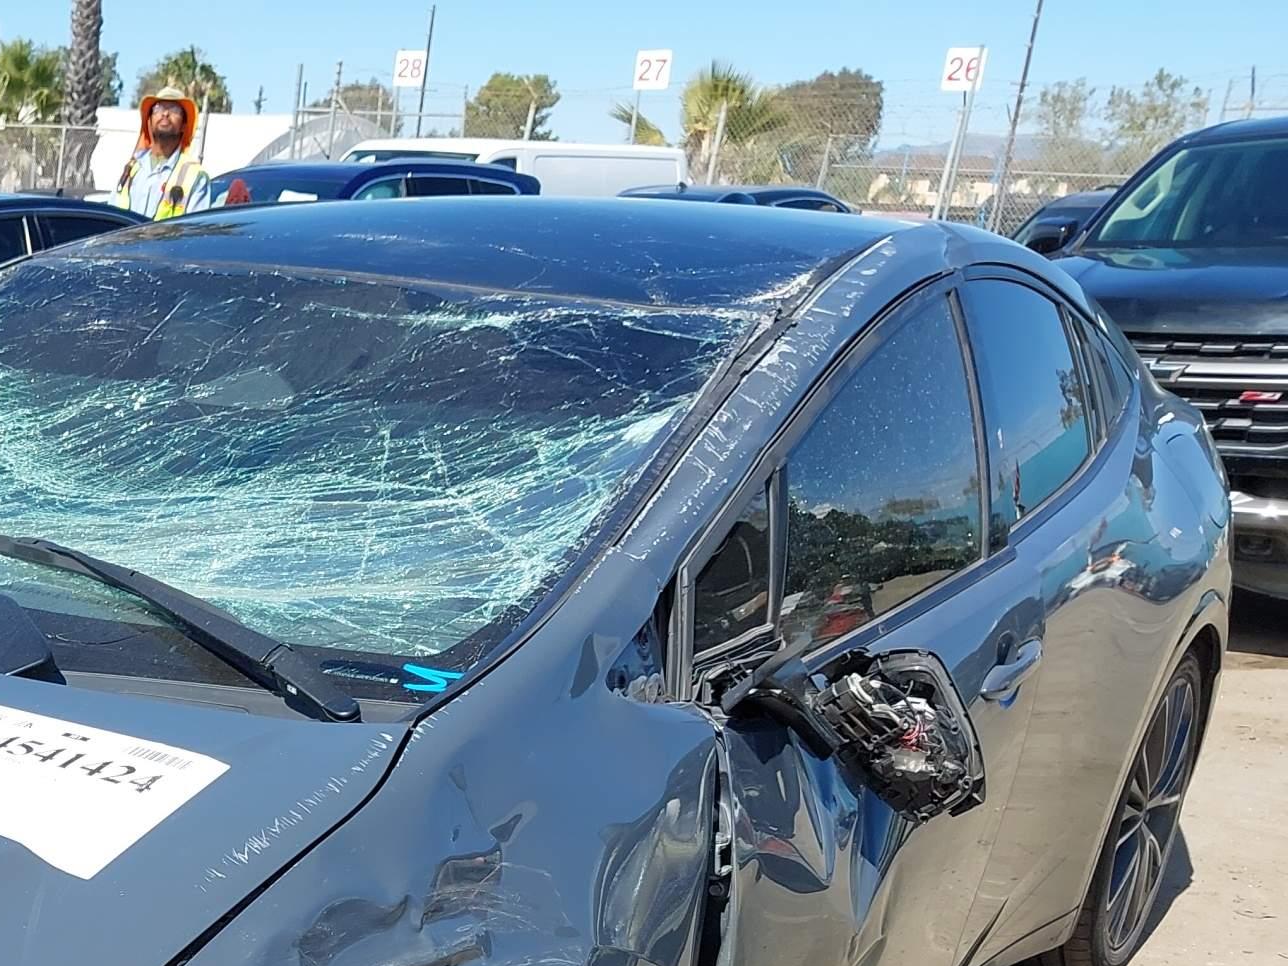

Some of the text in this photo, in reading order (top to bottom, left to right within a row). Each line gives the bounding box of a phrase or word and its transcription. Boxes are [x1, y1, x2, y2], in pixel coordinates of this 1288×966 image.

[398, 58, 422, 78] 28
[638, 59, 668, 81] 27
[947, 57, 980, 82] 26
